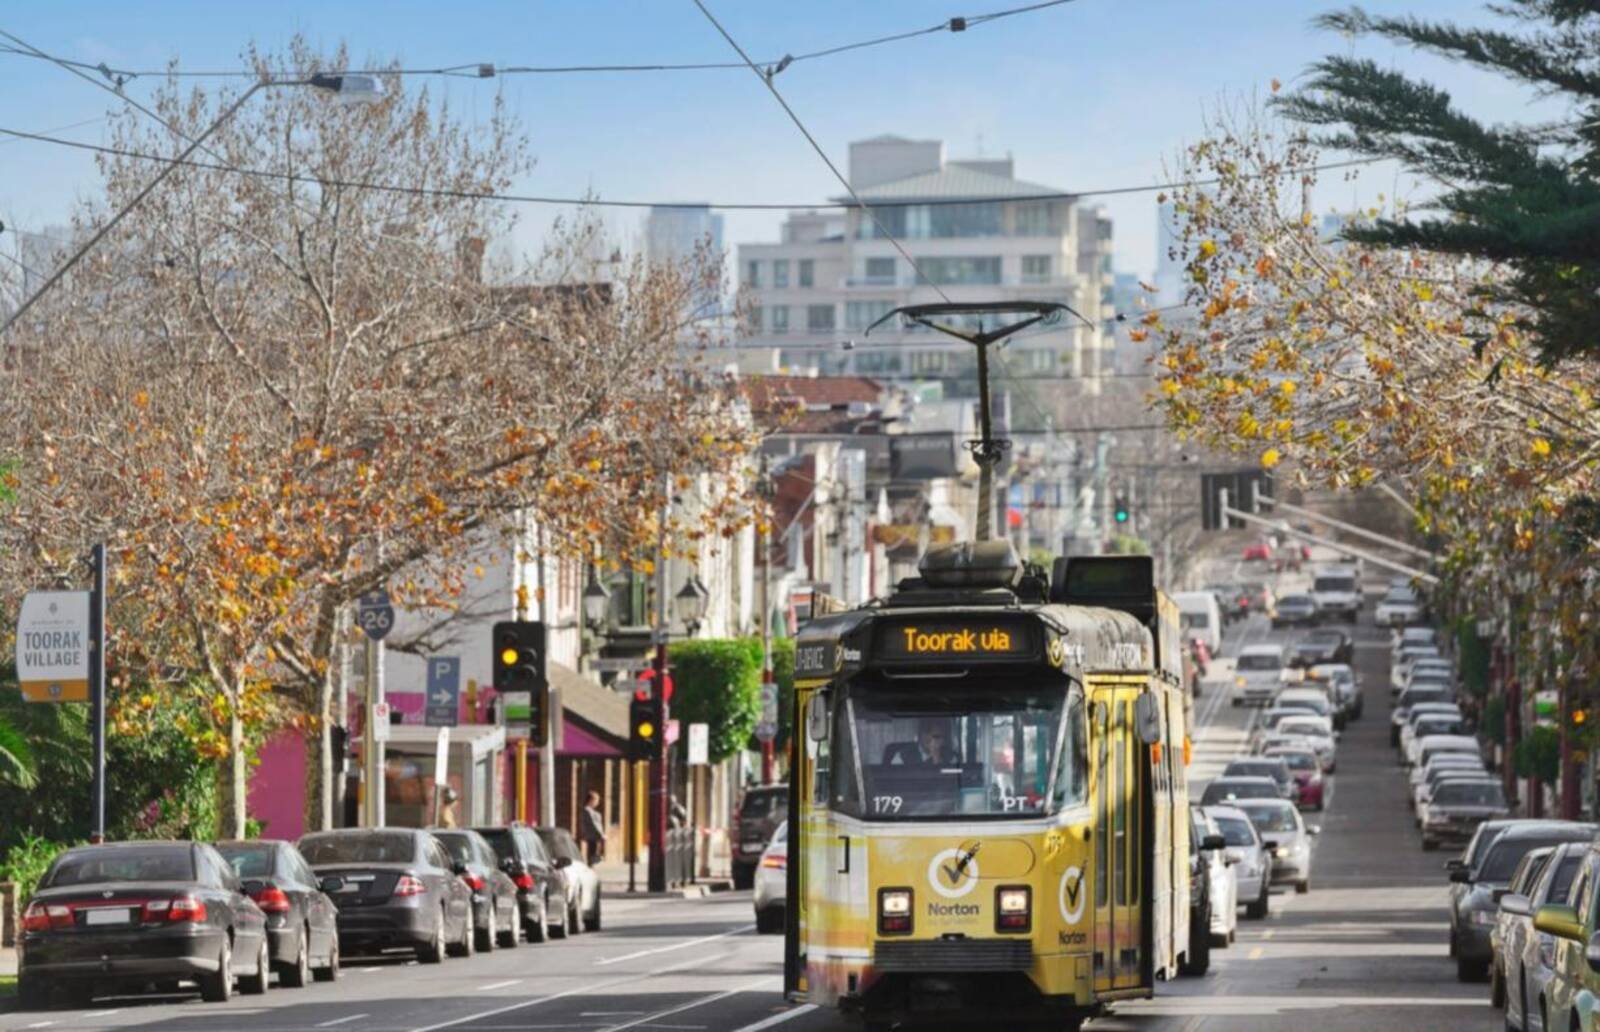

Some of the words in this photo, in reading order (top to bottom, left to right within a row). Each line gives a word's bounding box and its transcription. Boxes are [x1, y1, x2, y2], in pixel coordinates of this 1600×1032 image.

[364, 610, 390, 630] 26
[24, 630, 81, 650] TOORAK
[903, 626, 977, 652] Toorak
[980, 626, 1011, 652] via
[24, 650, 81, 667] VILLAGE
[435, 661, 451, 680] P
[873, 795, 904, 813] 179
[1002, 796, 1029, 812] PT
[927, 902, 980, 917] Norton
[1057, 930, 1087, 945] Norton
